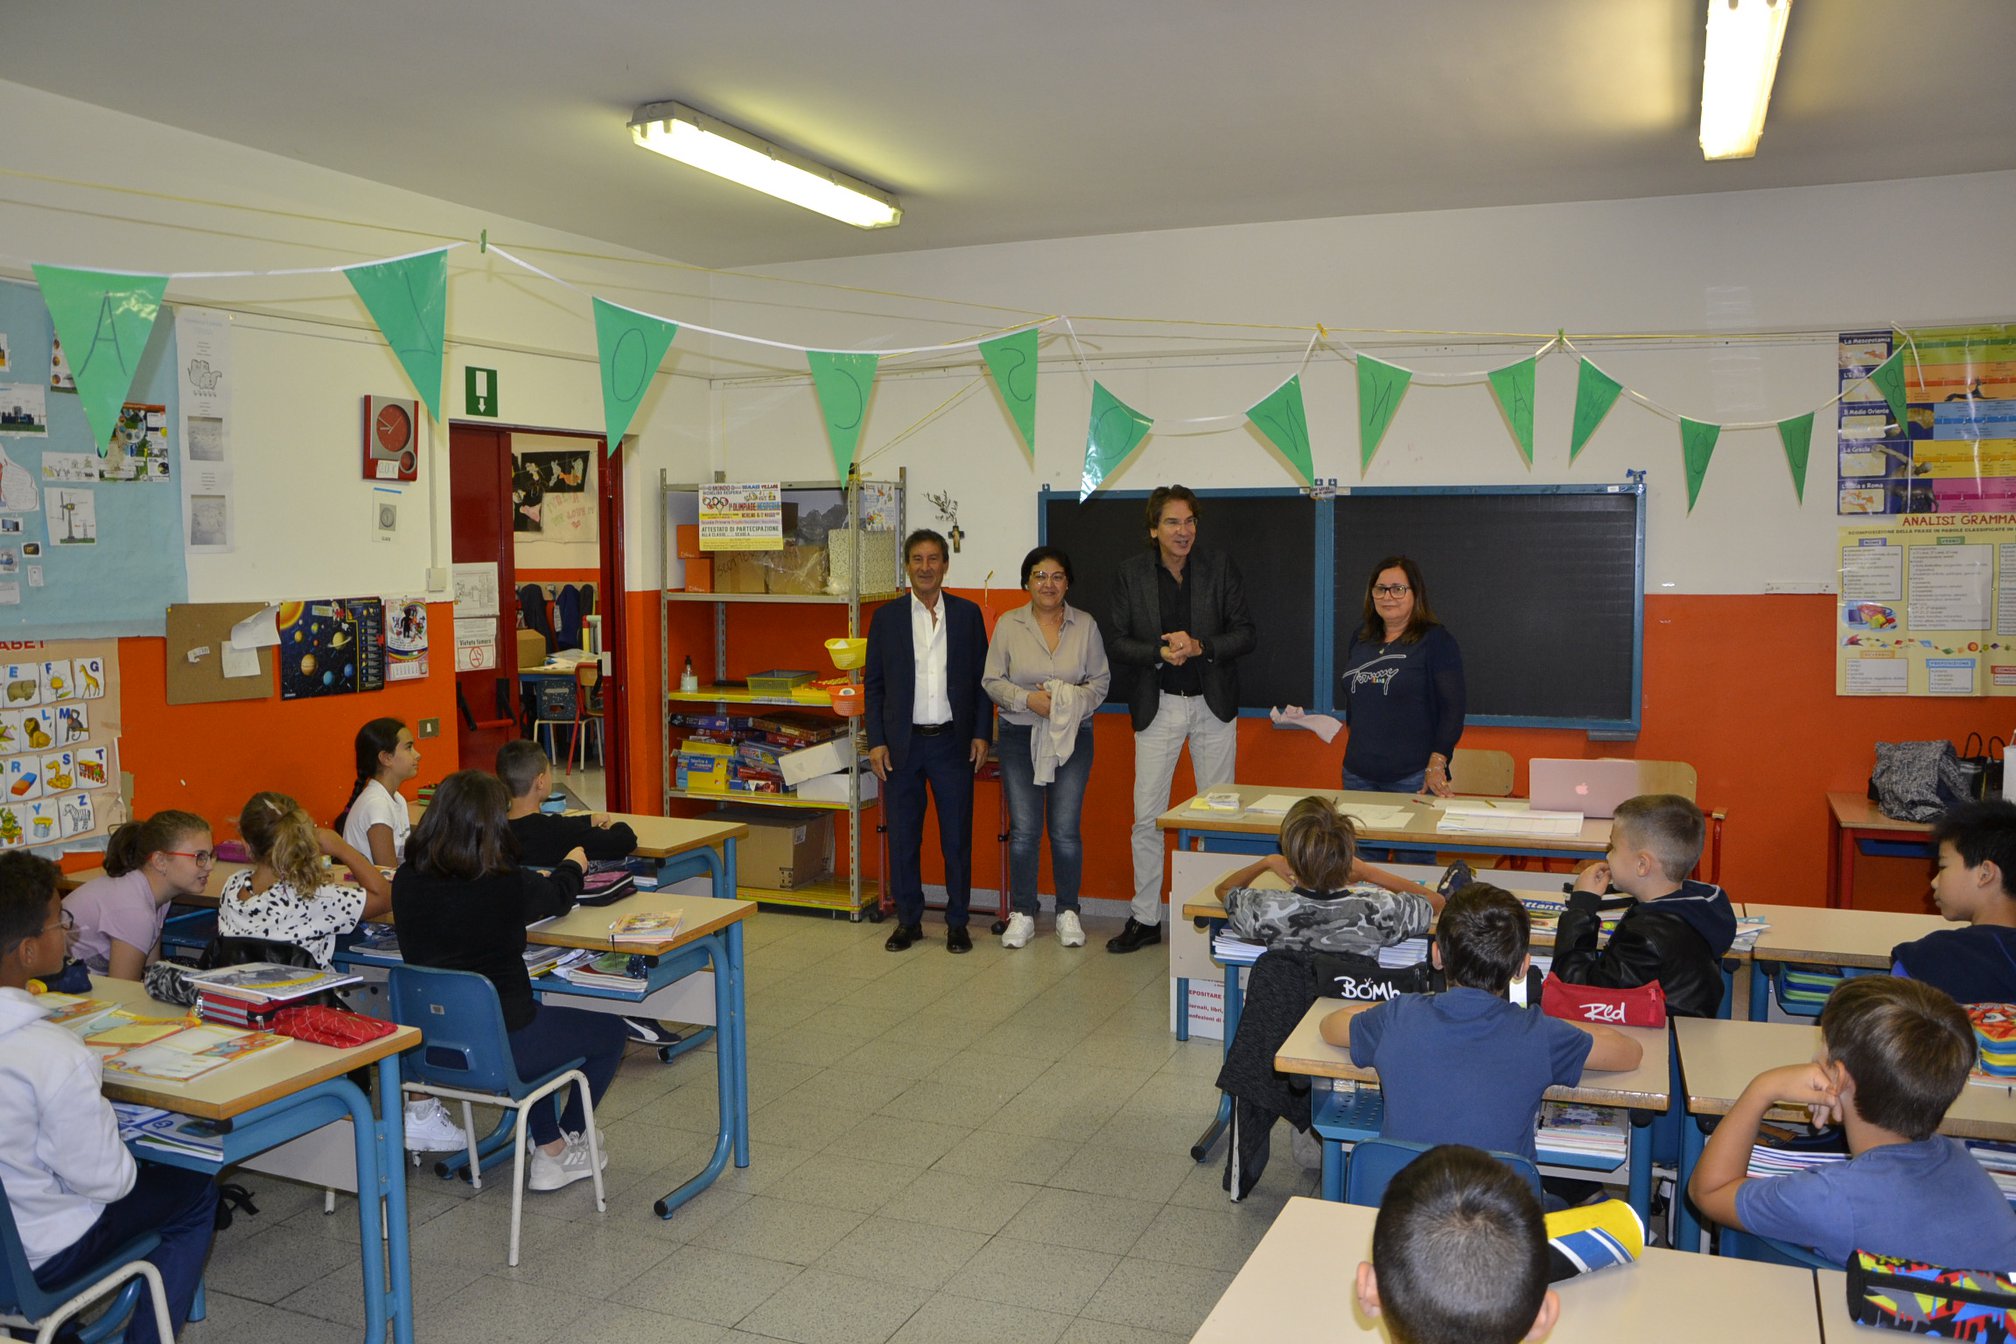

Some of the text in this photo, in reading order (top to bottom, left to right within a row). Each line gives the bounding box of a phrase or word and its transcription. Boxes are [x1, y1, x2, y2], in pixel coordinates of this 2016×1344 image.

[1902, 514, 2016, 526] ANALISI GRAMMA
[9, 666, 18, 678] E
[45, 663, 52, 674] F
[90, 661, 99, 672] G
[42, 709, 50, 721] L
[59, 708, 71, 719] M
[63, 754, 71, 765] S
[96, 749, 104, 760] T
[11, 761, 20, 772] R
[78, 794, 87, 806] Z
[33, 803, 42, 815] Y
[1580, 1002, 1625, 1023] Red
